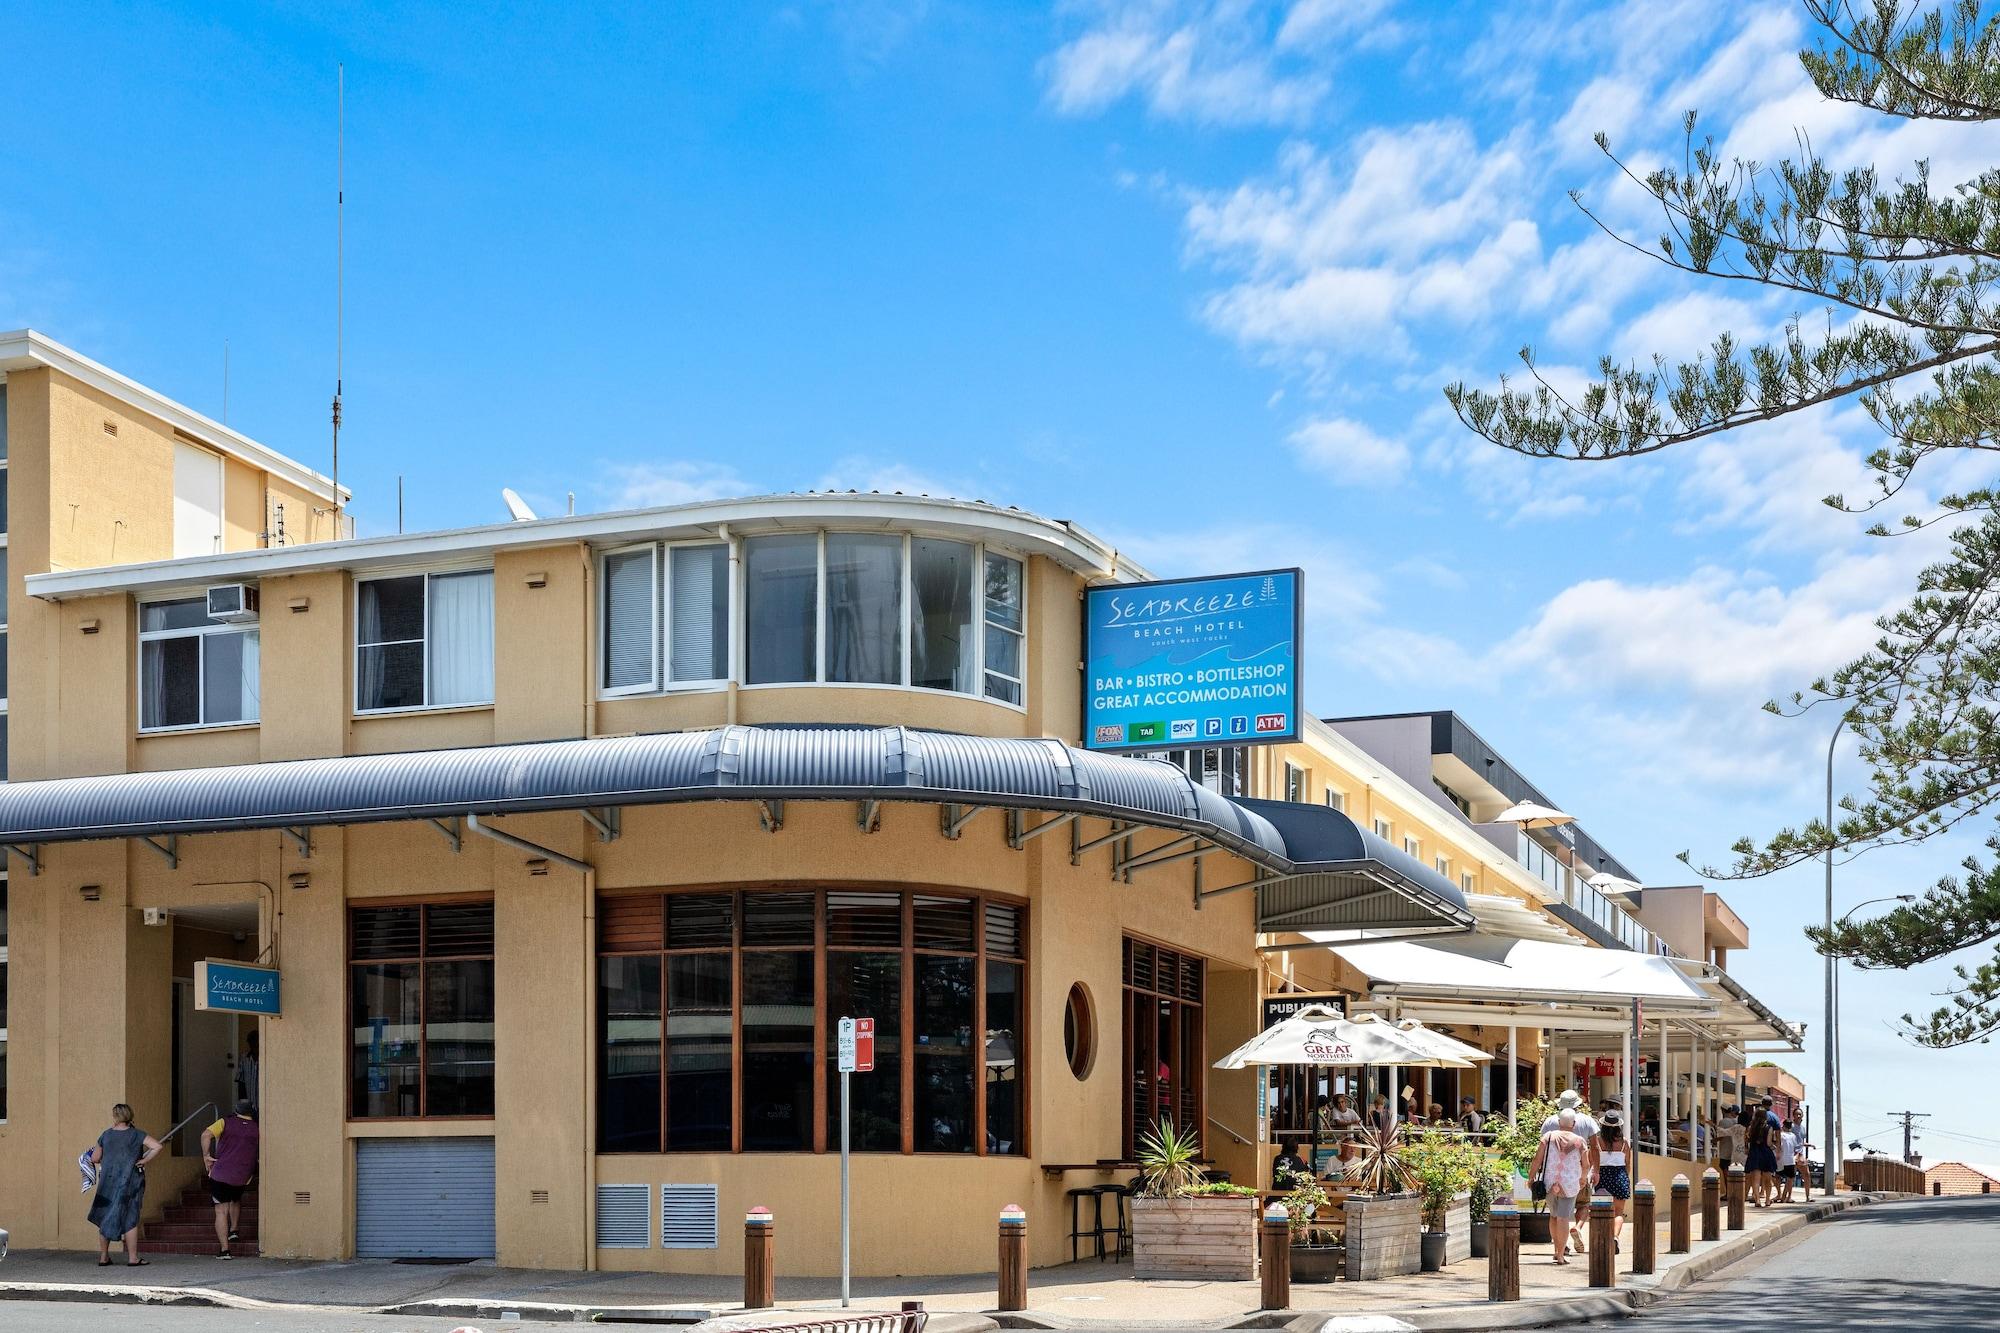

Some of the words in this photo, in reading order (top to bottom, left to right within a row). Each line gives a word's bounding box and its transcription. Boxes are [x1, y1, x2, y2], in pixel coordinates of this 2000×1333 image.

[1108, 591, 1254, 624] SEABREEZE
[1134, 626, 1183, 638] BEACH
[1194, 620, 1245, 632] HOTEL
[1151, 638, 1176, 647] south
[1203, 634, 1228, 642] rocks
[1096, 677, 1123, 691] BAR
[1136, 672, 1184, 688] BISTRO
[1197, 664, 1285, 683] BOTTLESHOP
[1094, 694, 1139, 710] GREAT
[1143, 683, 1287, 706] ACCOMMODATION
[1172, 723, 1195, 733] SKY
[1209, 721, 1219, 733] P
[1257, 718, 1284, 729] ATM
[1100, 727, 1120, 736] FOX
[1140, 728, 1153, 736] TAB
[212, 975, 267, 993] SEABREEZE
[222, 995, 242, 1003] BEACH
[1318, 1001, 1342, 1011] AR
[843, 1021, 852, 1032] 1P
[860, 1021, 869, 1030] NO
[1304, 1045, 1351, 1054] GREAT
